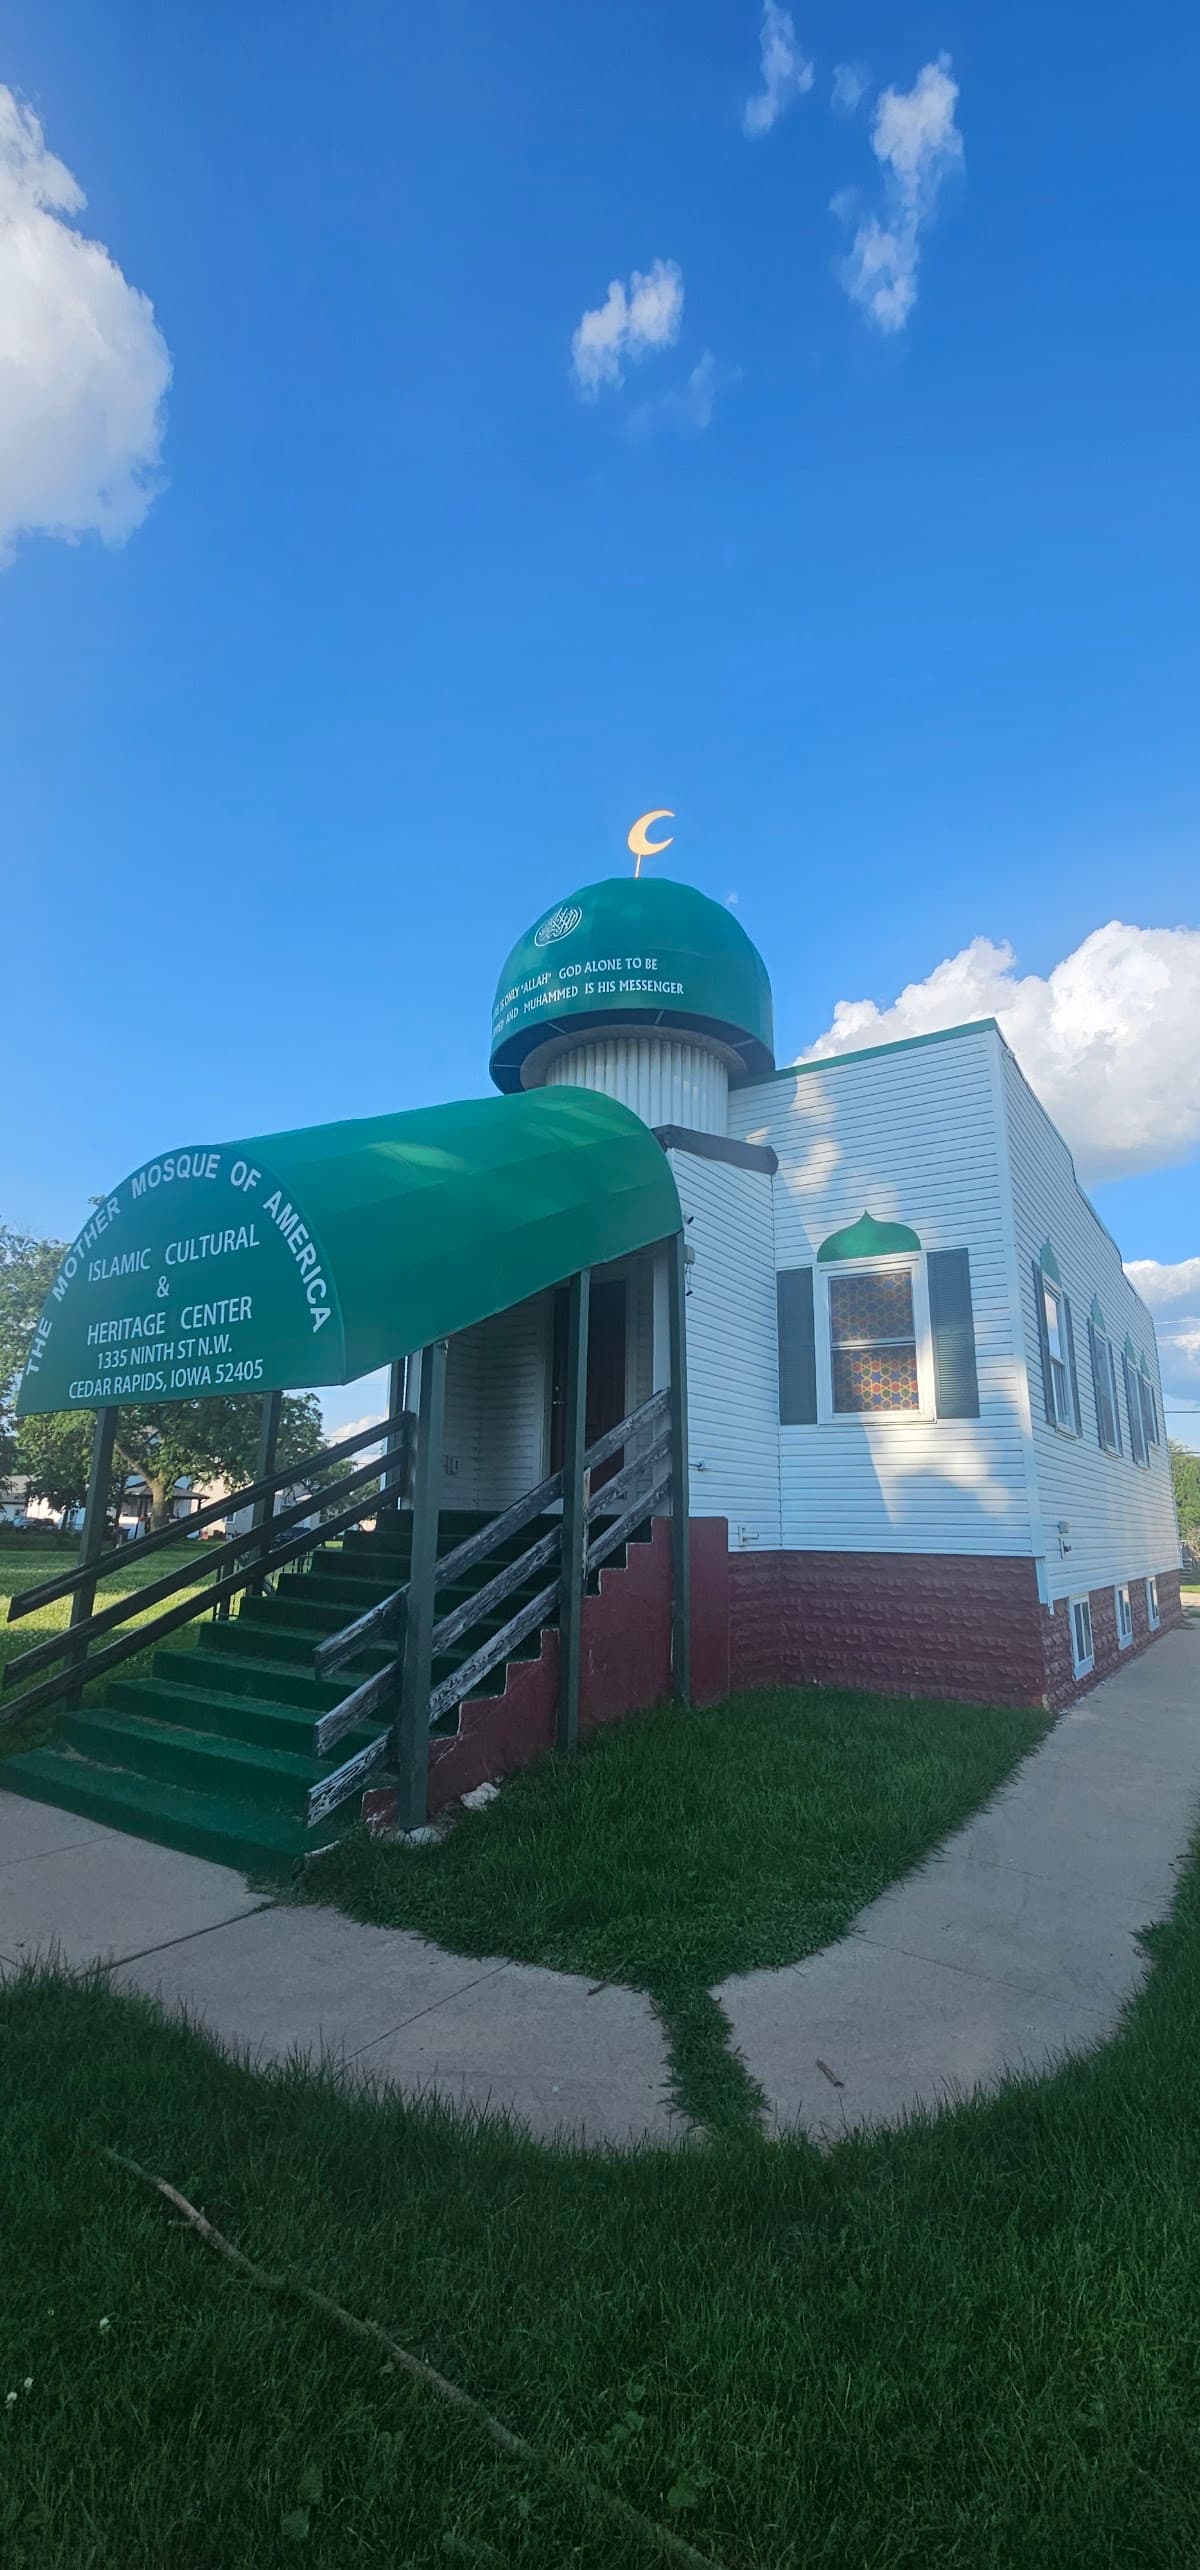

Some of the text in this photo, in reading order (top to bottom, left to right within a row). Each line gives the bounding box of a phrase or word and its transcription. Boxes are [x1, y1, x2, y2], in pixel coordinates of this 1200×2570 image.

[558, 964, 582, 979] GOD
[584, 958, 622, 974] ALONE
[625, 957, 642, 970] TO
[645, 958, 658, 970] BE
[505, 1007, 519, 1024] AND
[523, 985, 578, 1014] MUHAMMED
[585, 982, 594, 995] IS
[598, 981, 616, 993] HIS
[619, 979, 684, 995] MESSENGER
[26, 1152, 332, 1376] THE MOTHER MOSQUE OF AMERICA
[88, 1224, 260, 1282] ISLAMIC CULTURAL
[156, 1275, 170, 1298] &
[87, 1296, 252, 1346] HERITAGE CENTER
[97, 1333, 233, 1370] 1335 NINTH ST N.W.
[68, 1358, 264, 1400] CEDAR RAPIDS, IOWA 52405
